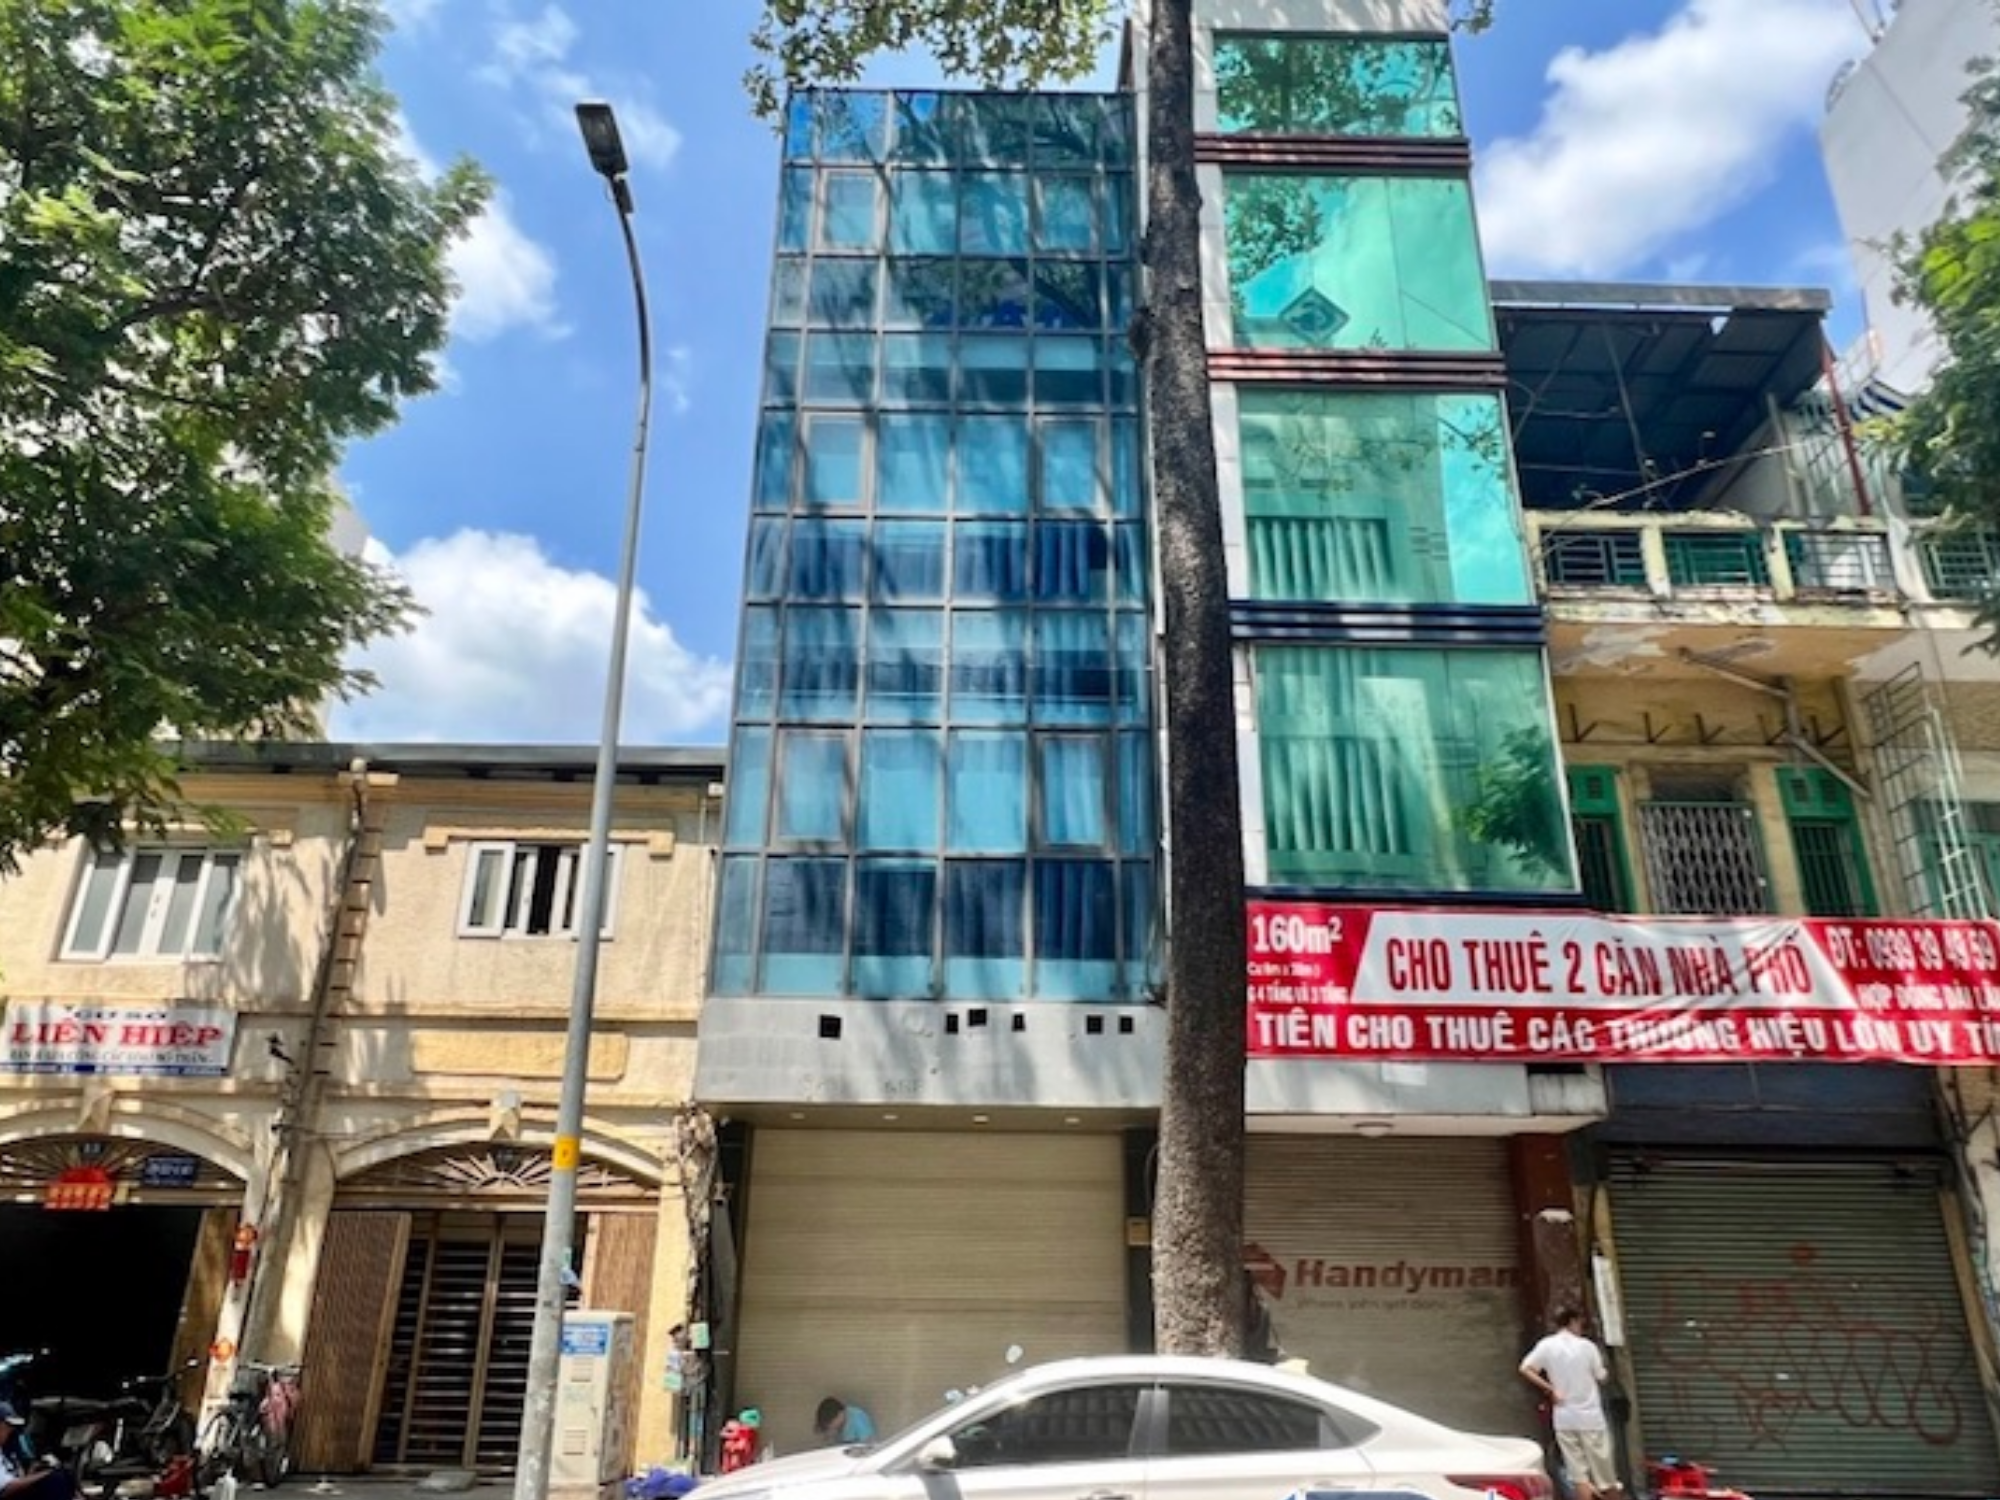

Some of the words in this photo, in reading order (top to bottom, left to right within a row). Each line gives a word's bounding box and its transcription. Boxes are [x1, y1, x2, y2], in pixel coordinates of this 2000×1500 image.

[1386, 938, 1451, 992] CHO
[1463, 930, 1553, 993] THUÊ
[1563, 941, 1586, 994] 2
[1595, 936, 1663, 996] CĂN
[1666, 935, 1739, 996] NHÀ
[11, 1018, 107, 1045] LIÊN
[1347, 1013, 1413, 1048] CHO
[1427, 1012, 1515, 1050] THUÊ
[1526, 1012, 1596, 1051] CÁC
[1295, 1259, 1519, 1293] Handyman
